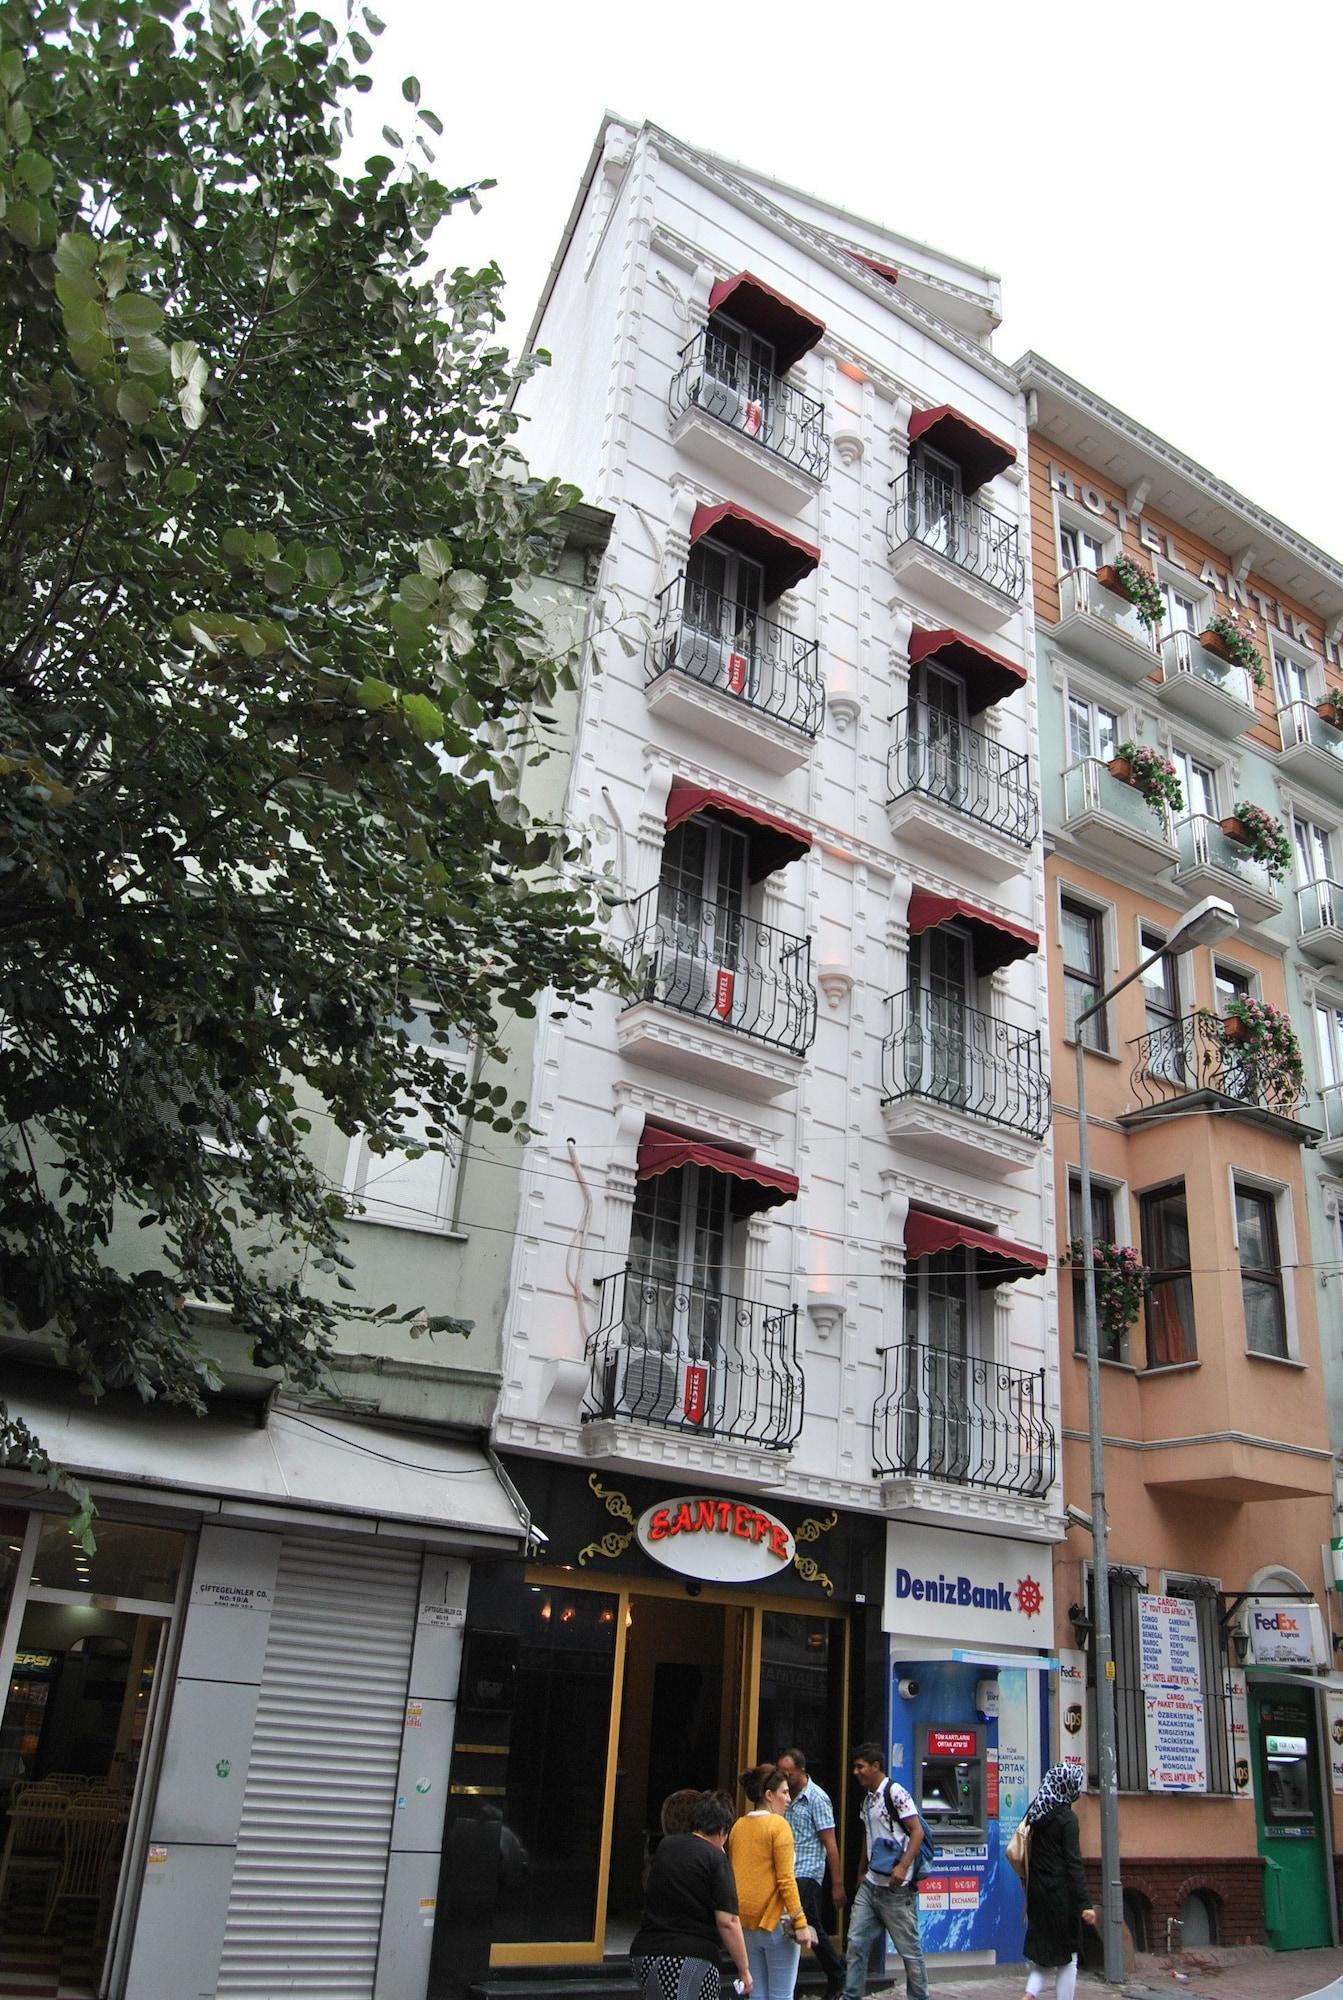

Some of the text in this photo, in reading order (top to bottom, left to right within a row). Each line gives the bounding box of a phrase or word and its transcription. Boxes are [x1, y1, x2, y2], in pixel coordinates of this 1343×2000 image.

[1049, 461, 1187, 572] HOTEL
[1200, 559, 1315, 651] ANTİK
[718, 976, 729, 1008] VESTEL
[689, 1372, 700, 1410] VESTEL
[648, 1499, 789, 1561] SANTEFE
[896, 1568, 1012, 1611] DenizBank
[1157, 1597, 1177, 1607] CARGO
[1149, 1604, 1161, 1613] TOUT
[1162, 1606, 1171, 1614] LES
[1141, 1615, 1158, 1623] CONGO
[1254, 1612, 1298, 1631] FedEx
[1141, 1623, 1158, 1631] GHANA
[1280, 1631, 1300, 1639] Express
[1142, 1639, 1159, 1647] MAROC
[1143, 1647, 1162, 1655] SOUDAN
[1061, 1665, 1082, 1679] FedEx
[1152, 1673, 1167, 1683] HOTEL
[1166, 1693, 1184, 1701] CARGO
[1157, 1700, 1175, 1709] PAKET
[1157, 1710, 1194, 1720] ÖZBEKİSTAN
[1064, 1711, 1081, 1730] ups
[998, 1763, 1025, 1772] ORTAK
